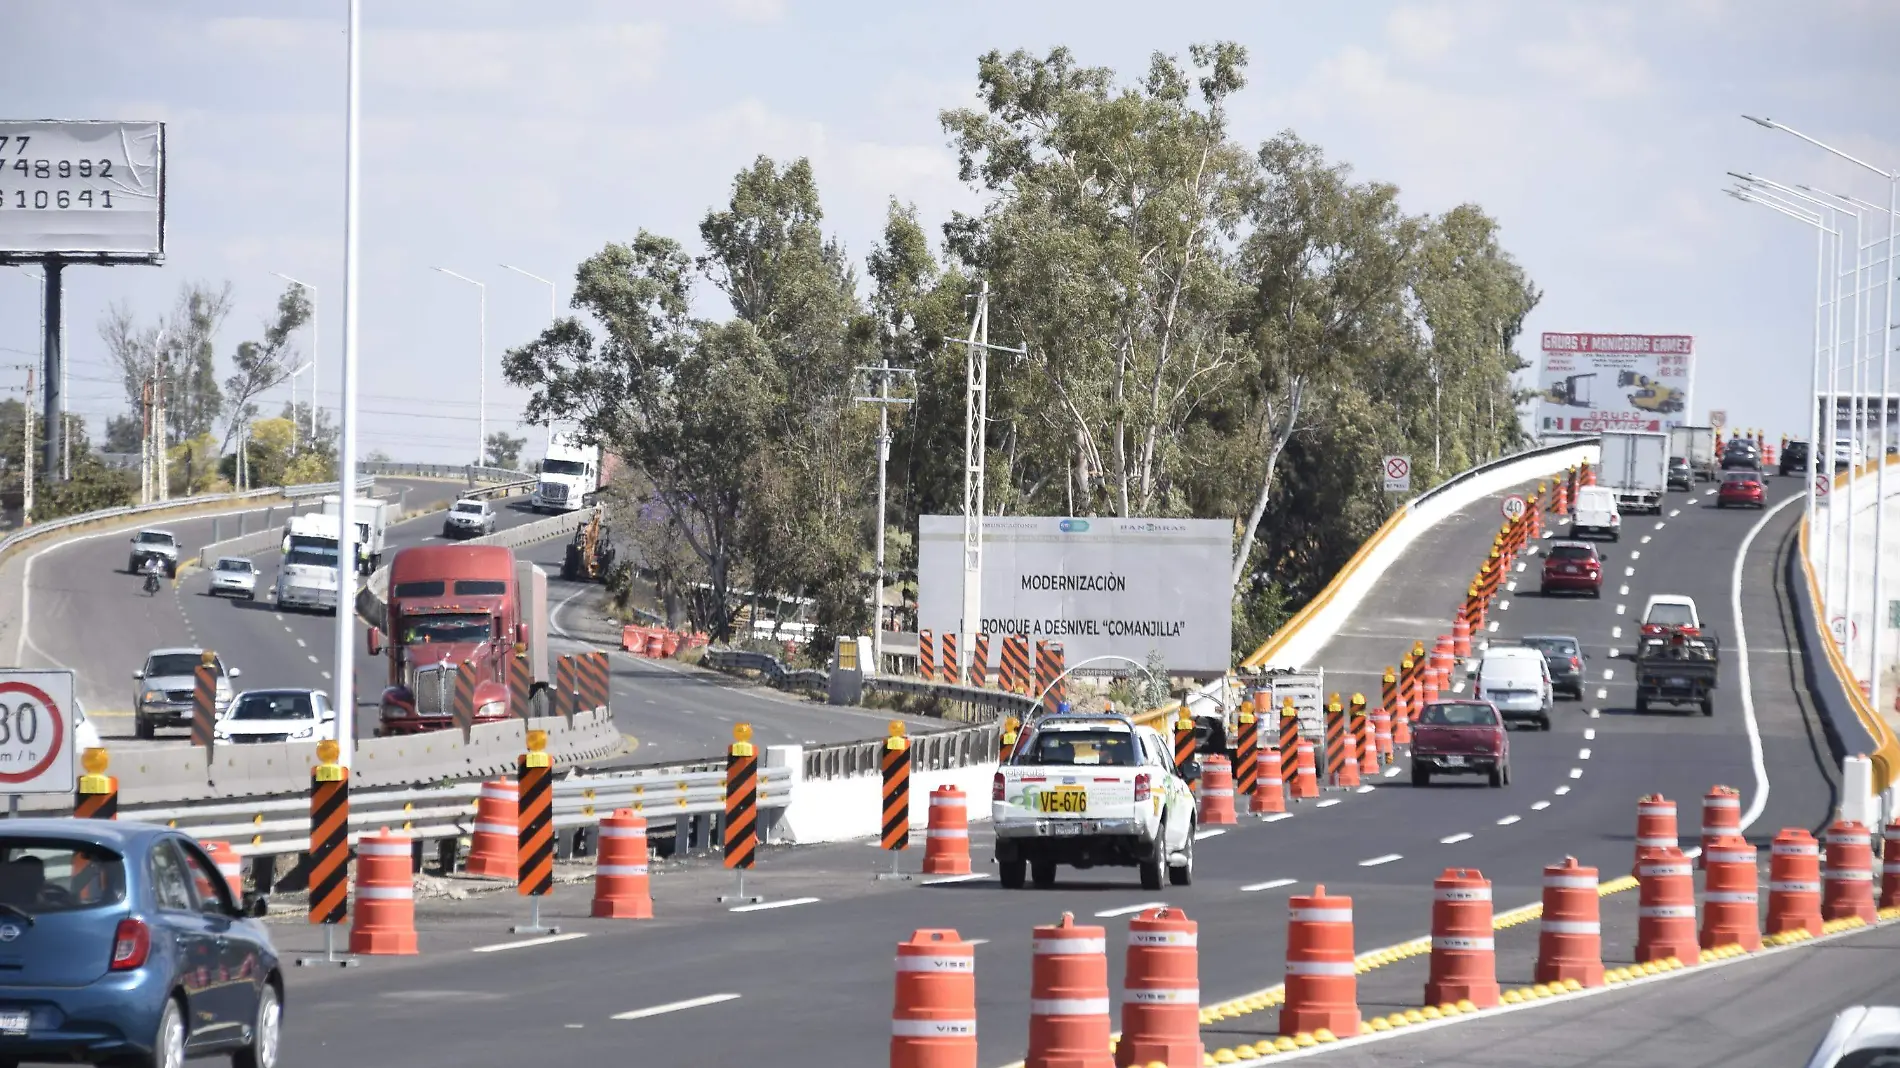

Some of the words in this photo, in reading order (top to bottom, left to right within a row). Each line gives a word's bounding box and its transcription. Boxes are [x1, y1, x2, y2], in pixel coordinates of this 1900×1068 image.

[0, 189, 113, 210] 10641
[1033, 620, 1042, 634] A
[1044, 620, 1100, 635] DESNIVEL
[1040, 790, 1087, 813] VE-676
[934, 960, 966, 968] VISE
